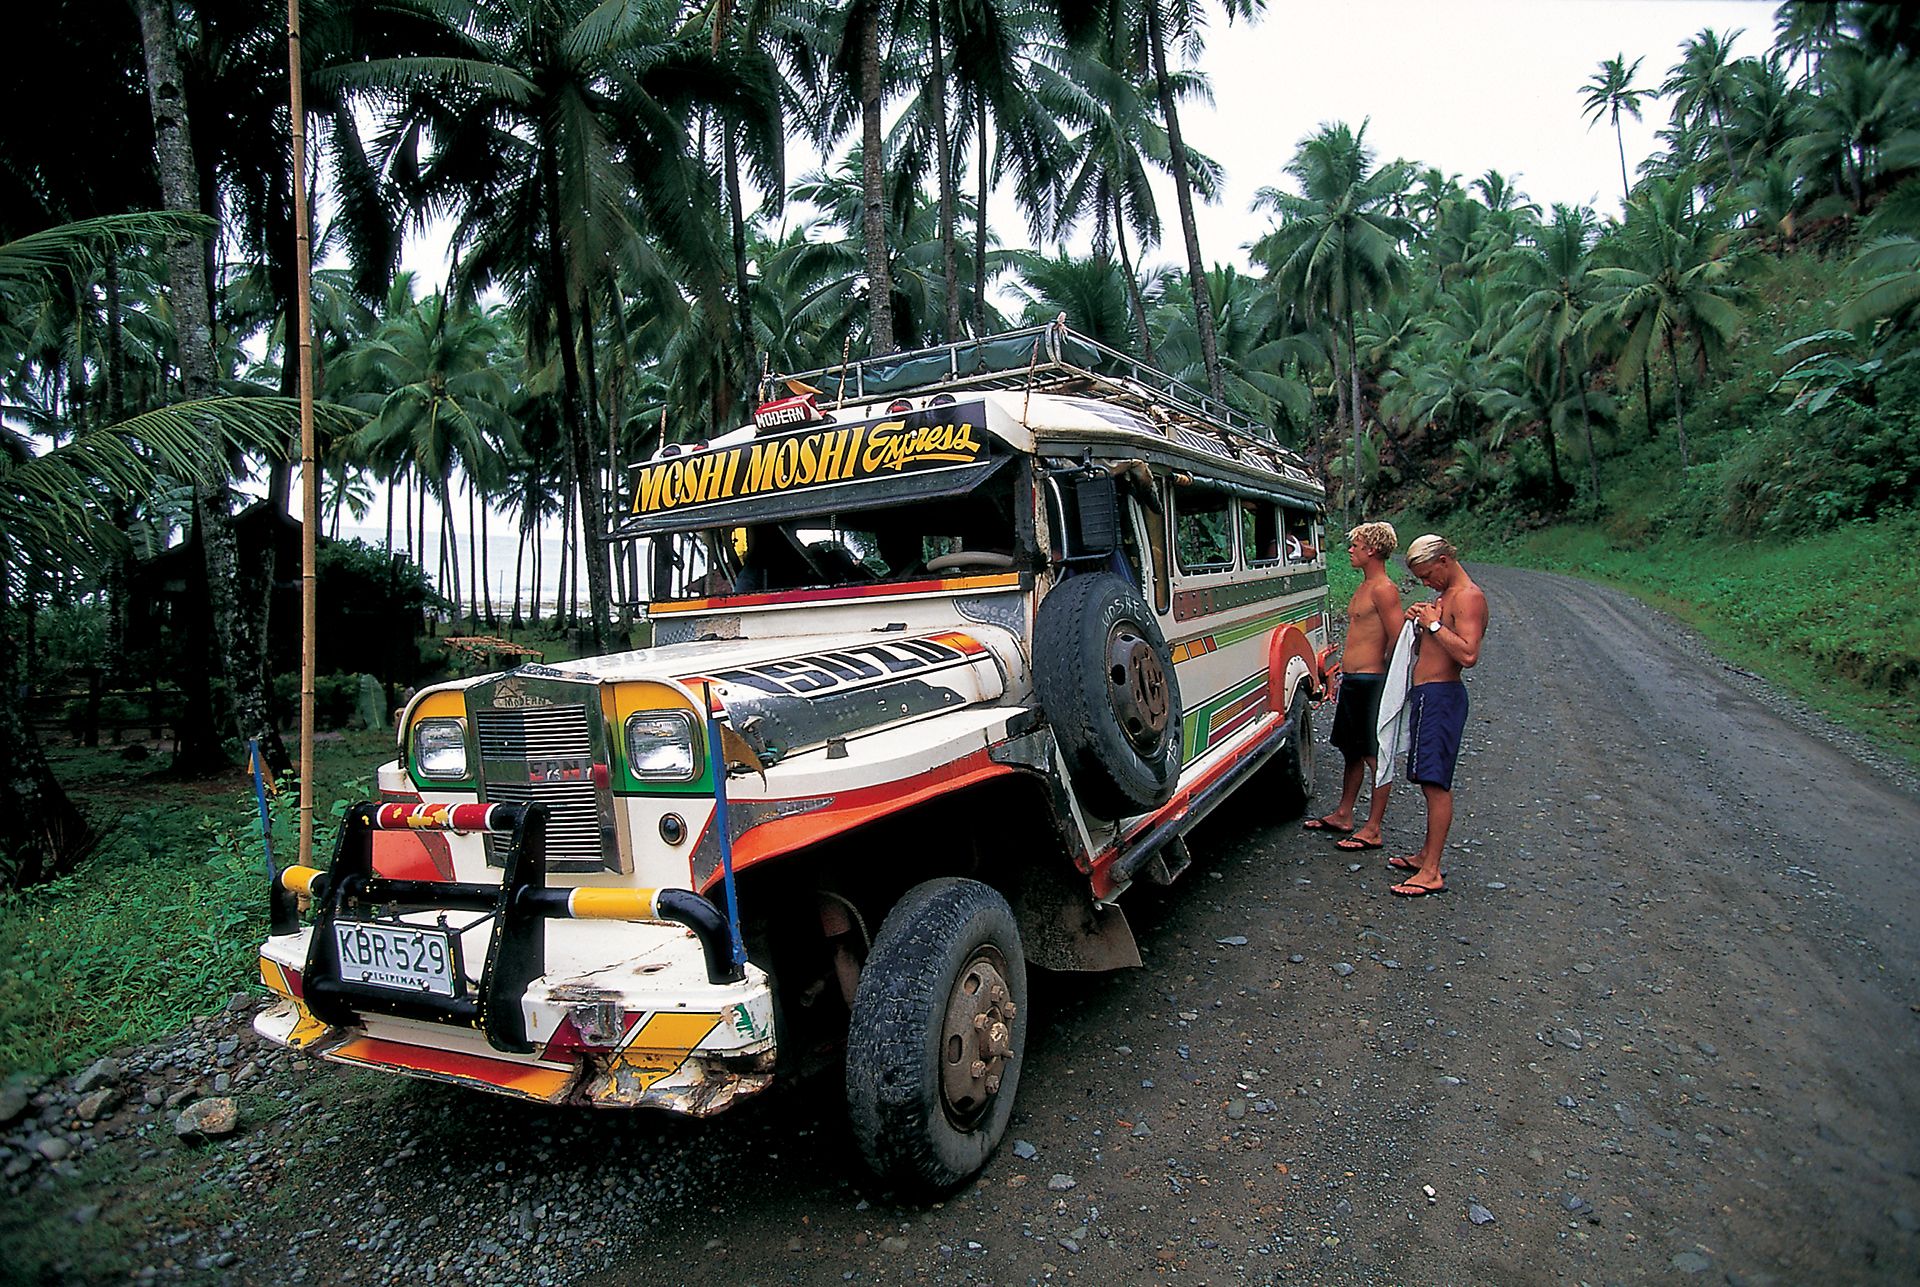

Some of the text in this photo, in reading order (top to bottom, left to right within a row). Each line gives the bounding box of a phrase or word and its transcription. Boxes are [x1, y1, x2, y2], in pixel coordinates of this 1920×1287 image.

[755, 406, 806, 428] MODERN
[631, 419, 982, 514] MOSHI MOSHI Express
[705, 639, 962, 694] ISUZU
